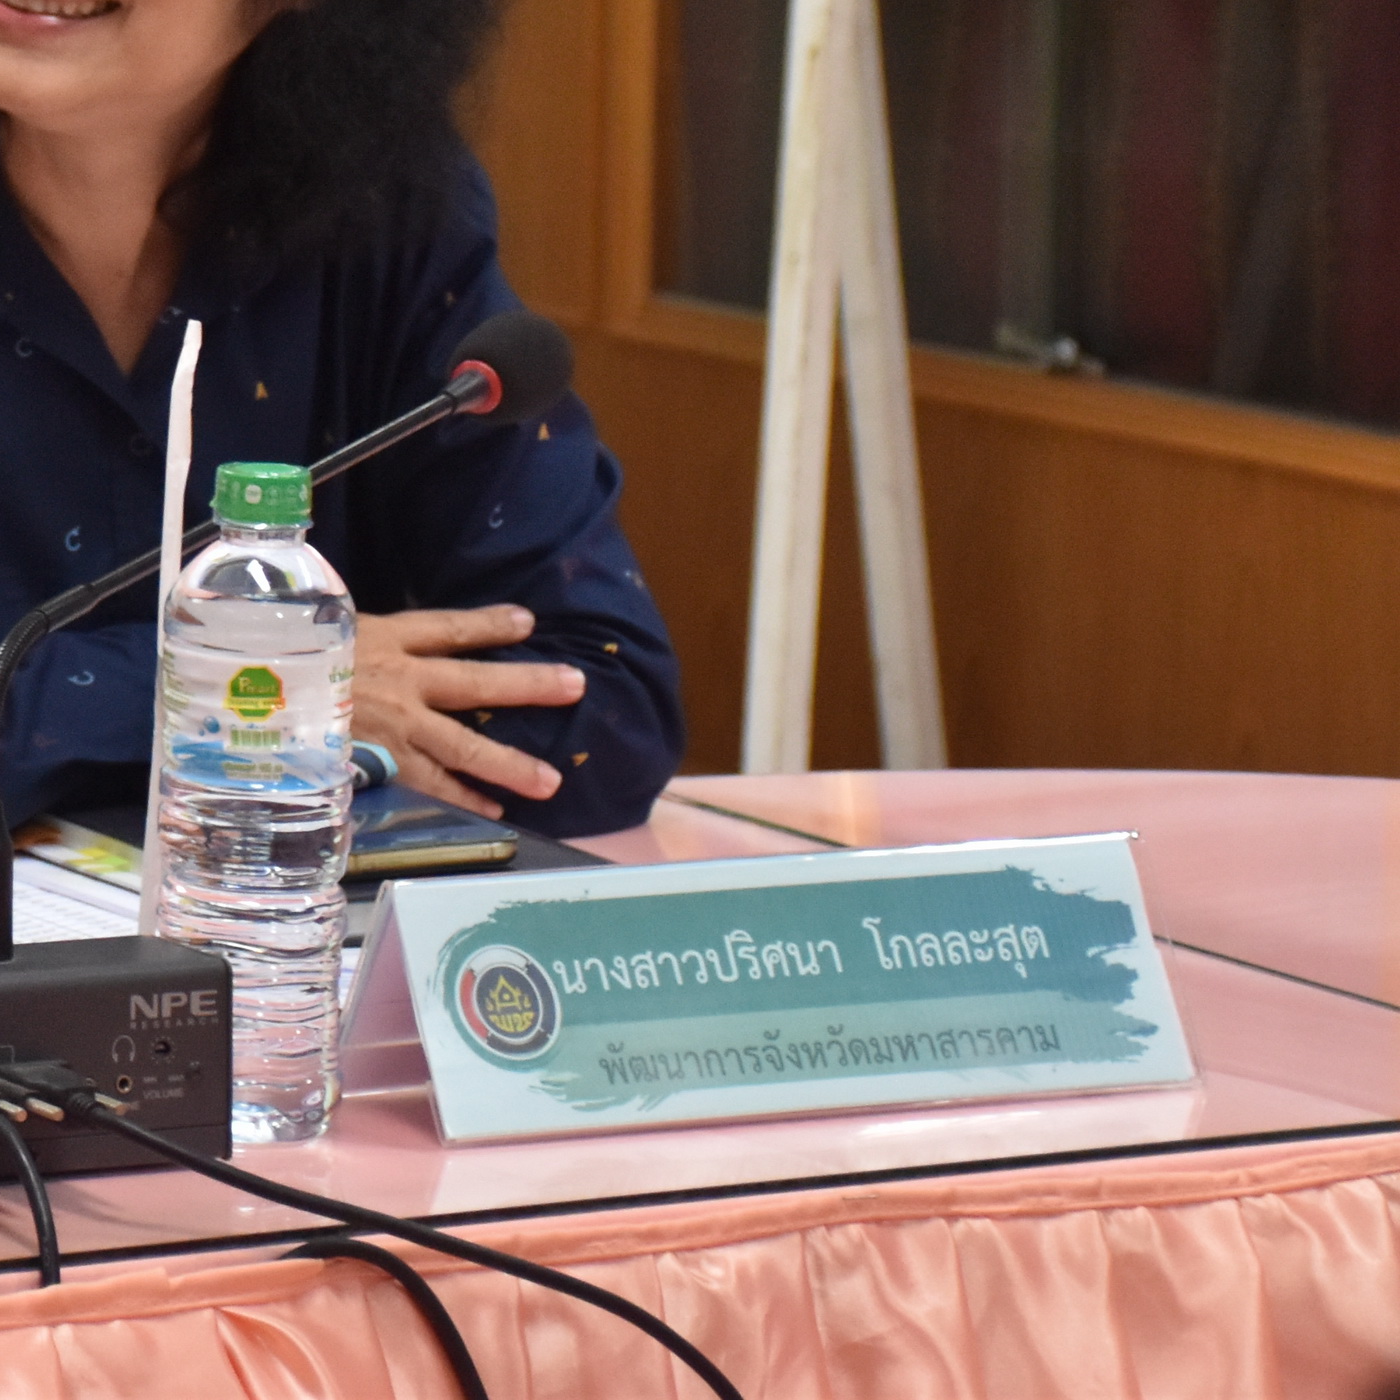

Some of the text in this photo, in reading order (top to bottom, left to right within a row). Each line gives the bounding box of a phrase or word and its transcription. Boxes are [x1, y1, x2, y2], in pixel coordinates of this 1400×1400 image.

[552, 916, 1050, 992] นางสาวปริศนา โกลละสุต
[129, 989, 219, 1021] NPE
[598, 1023, 1061, 1086] พัฒนาการจังหวัดมหาสารคาม
